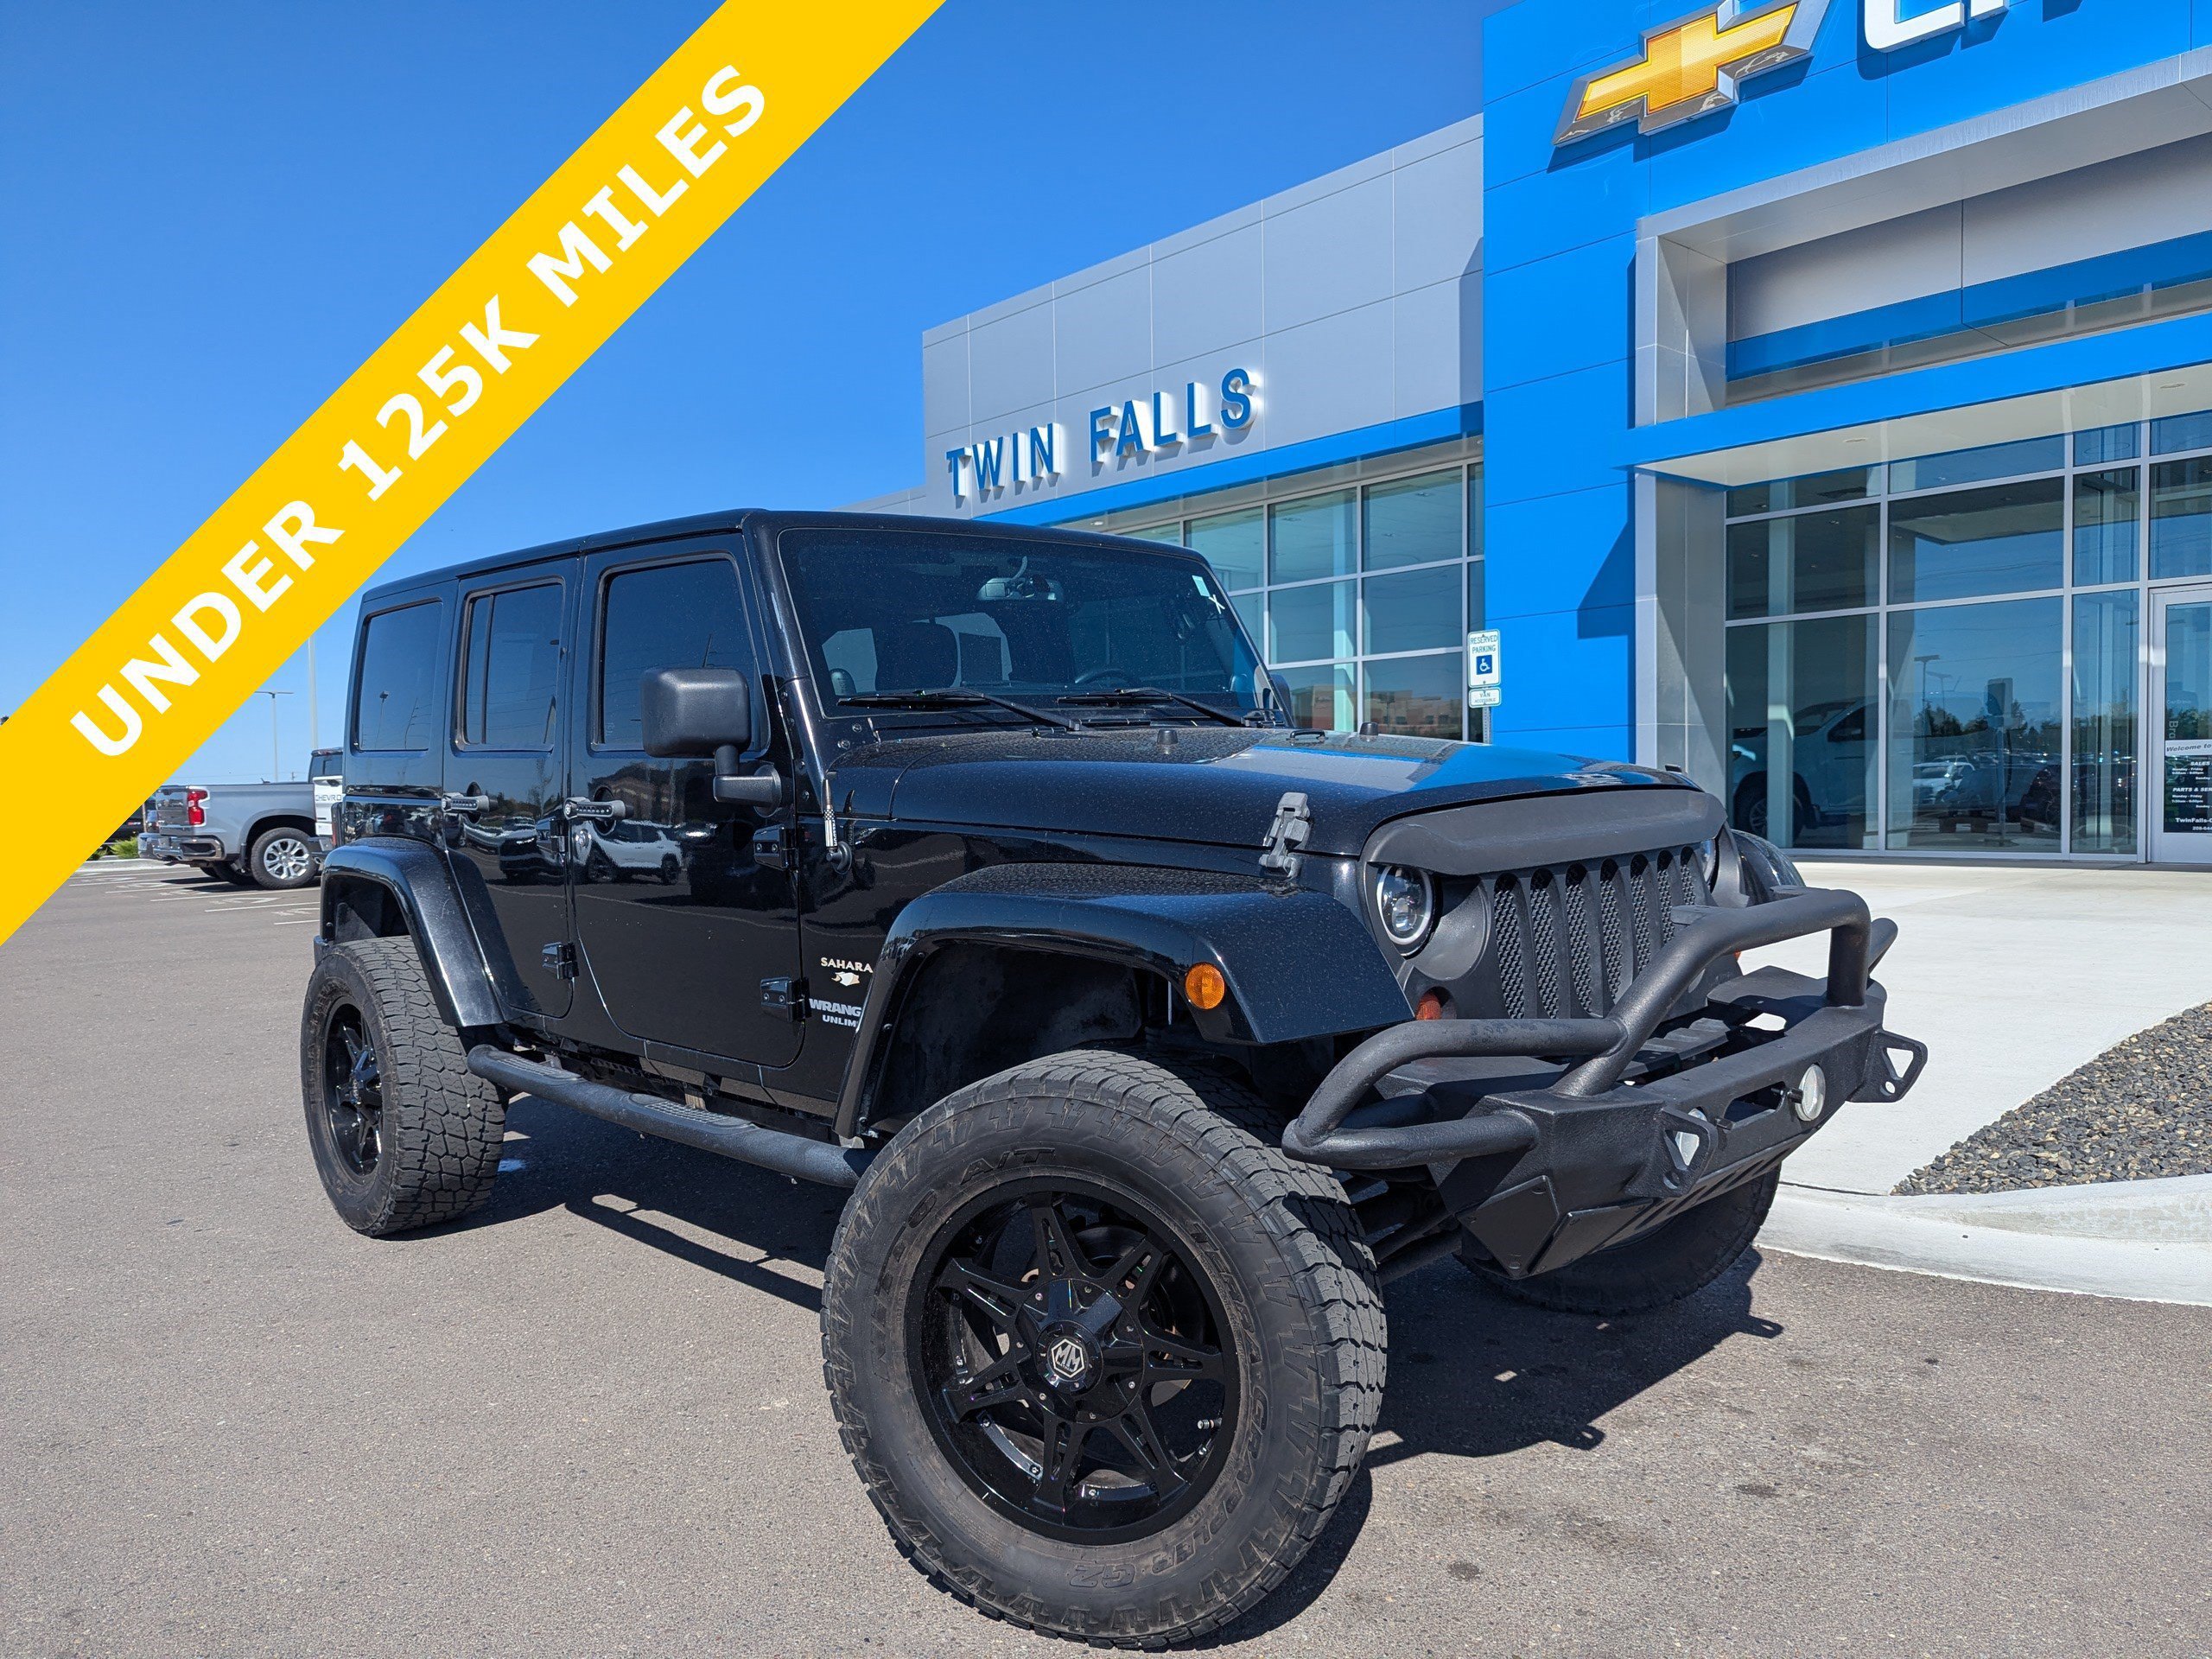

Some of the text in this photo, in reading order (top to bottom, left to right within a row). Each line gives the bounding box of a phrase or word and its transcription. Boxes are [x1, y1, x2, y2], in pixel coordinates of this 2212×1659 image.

[946, 368, 1258, 498] TWIN FALLS
[1470, 634, 1498, 645] RESERVED
[1471, 645, 1496, 654] PARKING
[820, 957, 874, 974] SAHARA
[809, 998, 862, 1018] WRANG
[822, 1014, 859, 1027] UNLIM
[1190, 1214, 1262, 1363] TERRA
[1069, 1563, 1136, 1589] G2
